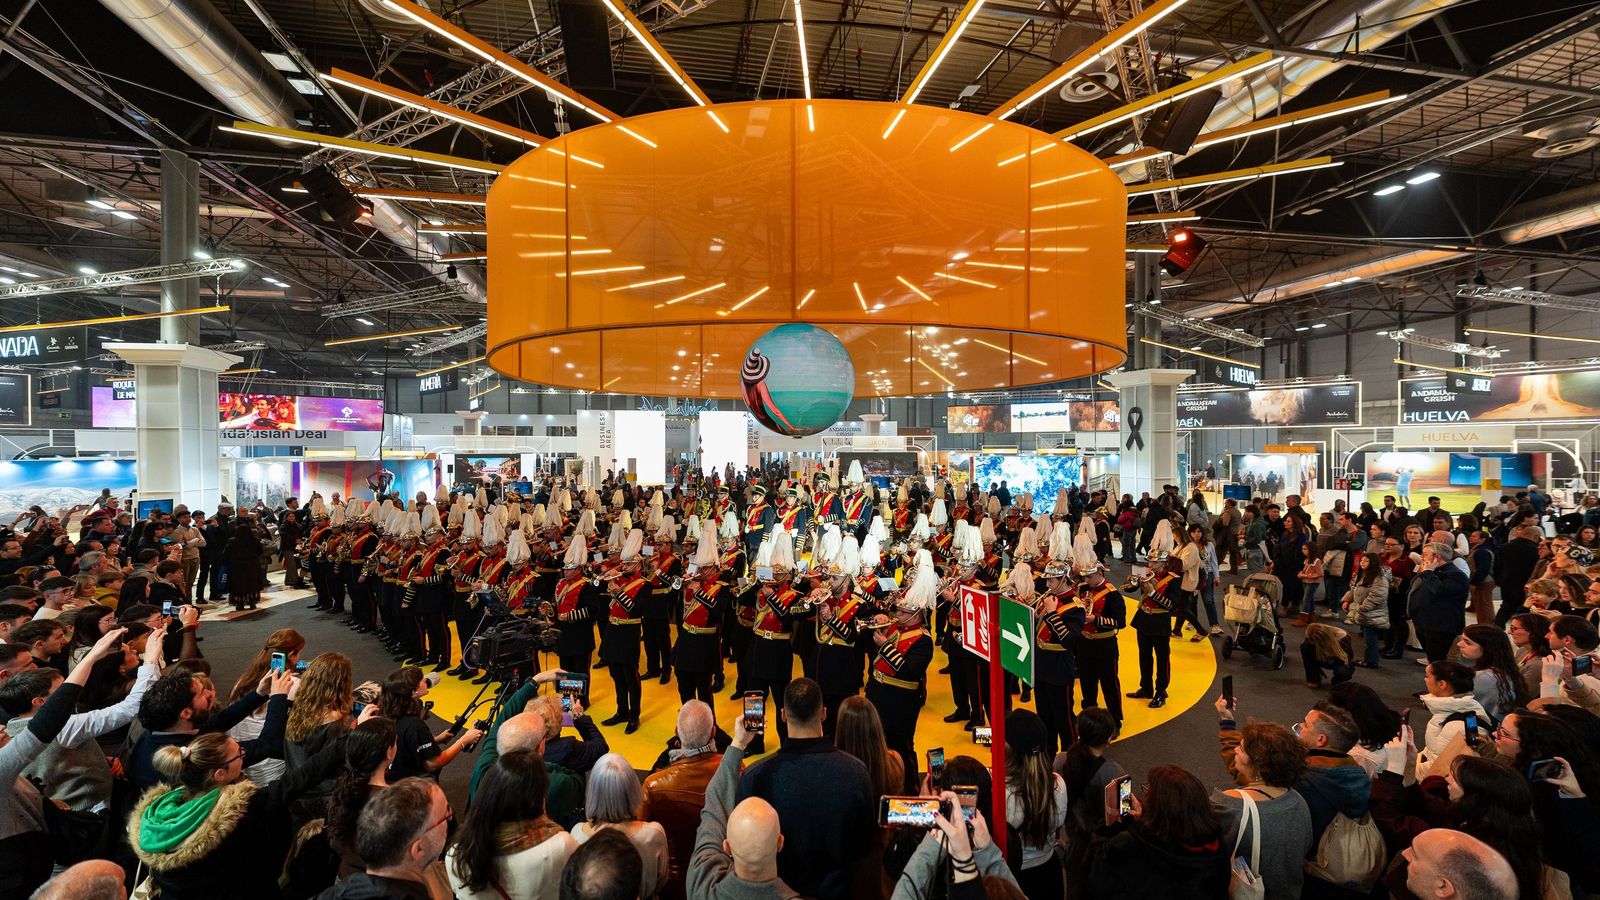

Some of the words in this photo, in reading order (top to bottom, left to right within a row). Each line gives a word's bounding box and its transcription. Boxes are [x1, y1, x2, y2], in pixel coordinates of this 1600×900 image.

[1230, 366, 1256, 385] HUELVA
[117, 391, 125, 399] DE
[1177, 399, 1217, 407] ANDALUSIAN
[1403, 410, 1470, 422] HUELVA
[295, 429, 327, 439] Deal
[1421, 432, 1479, 442] HUELVA
